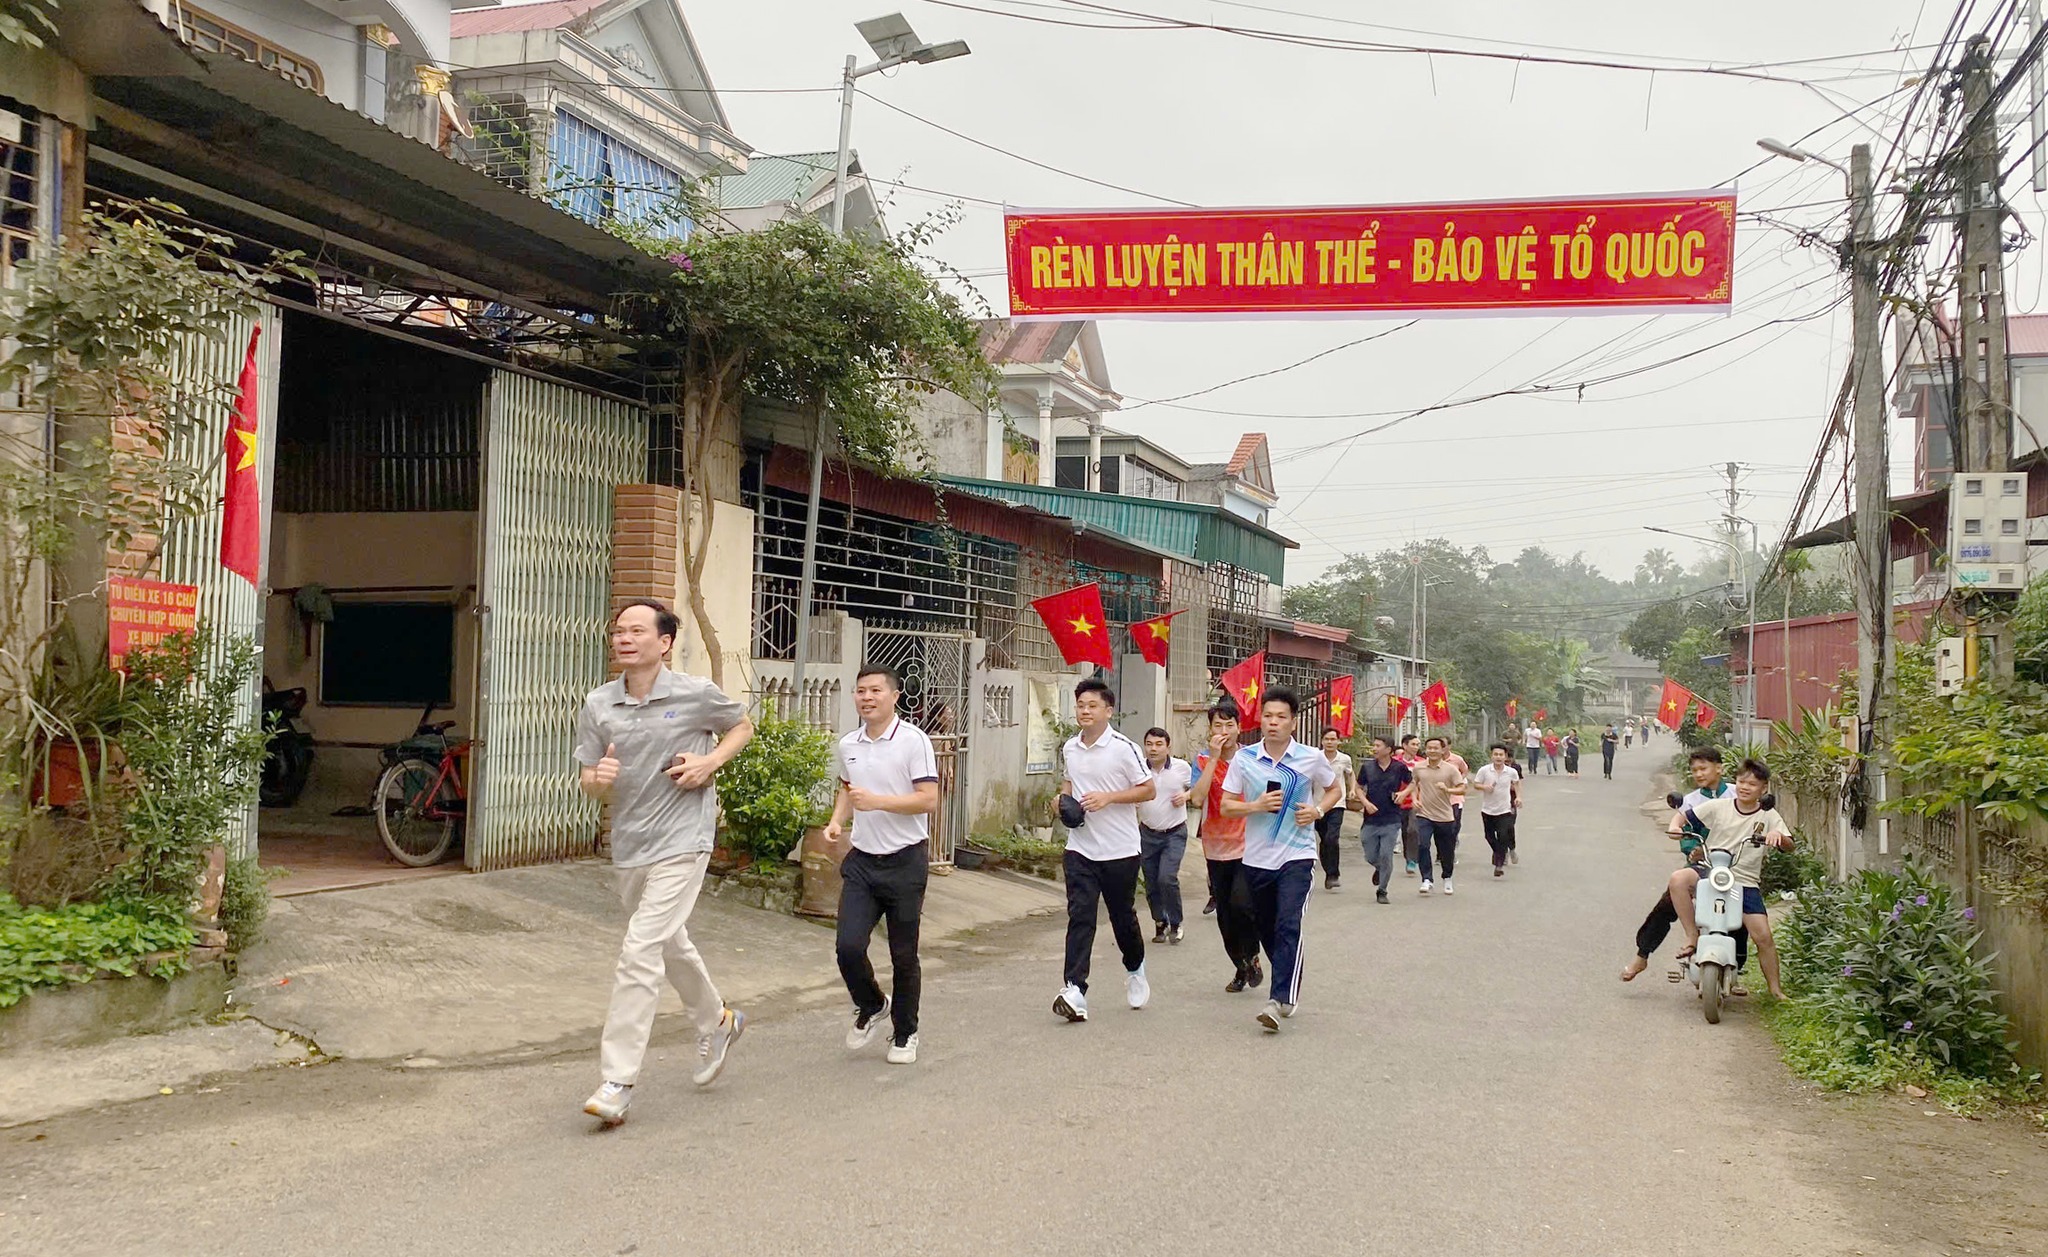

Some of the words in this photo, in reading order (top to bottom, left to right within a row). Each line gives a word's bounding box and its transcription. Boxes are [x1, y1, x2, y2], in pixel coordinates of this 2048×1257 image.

[1031, 236, 1095, 288] RÈN
[1105, 234, 1206, 296] LUYỆN
[1216, 231, 1304, 286] THÂN
[1315, 220, 1380, 284] THỂ
[1387, 259, 1401, 269] -
[1412, 221, 1483, 282] BẢO
[1495, 225, 1538, 290] VỆ
[1550, 215, 1597, 280] TỔ
[1606, 215, 1706, 284] QUỐC
[148, 588, 160, 604] XE
[163, 591, 174, 606] 16
